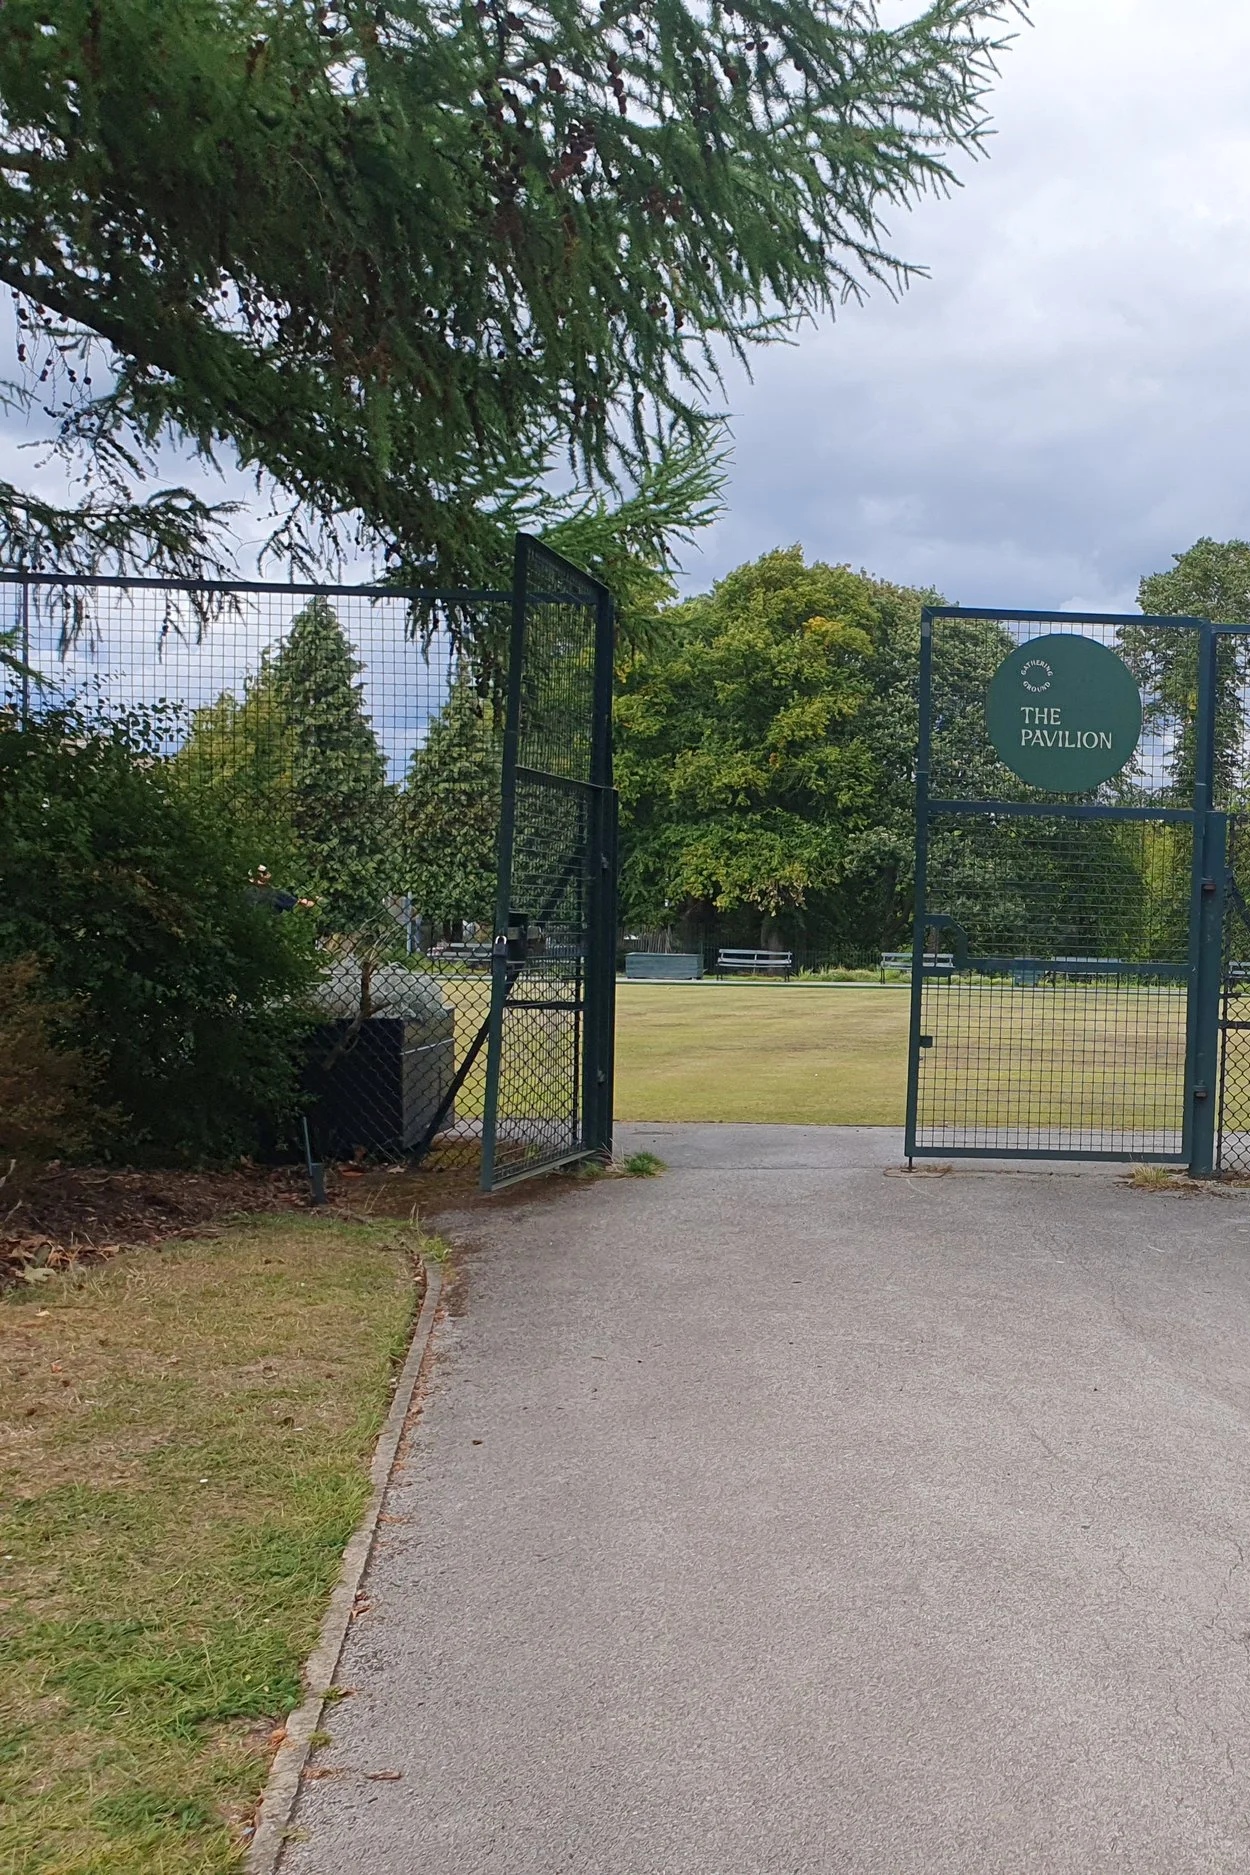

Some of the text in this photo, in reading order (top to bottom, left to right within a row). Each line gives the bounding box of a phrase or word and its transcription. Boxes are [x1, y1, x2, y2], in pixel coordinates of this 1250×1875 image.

[1020, 659, 1054, 677] GATHERING
[1022, 680, 1051, 693] GROUND
[1020, 706, 1061, 725] THE
[1020, 729, 1112, 749] PAVILION
